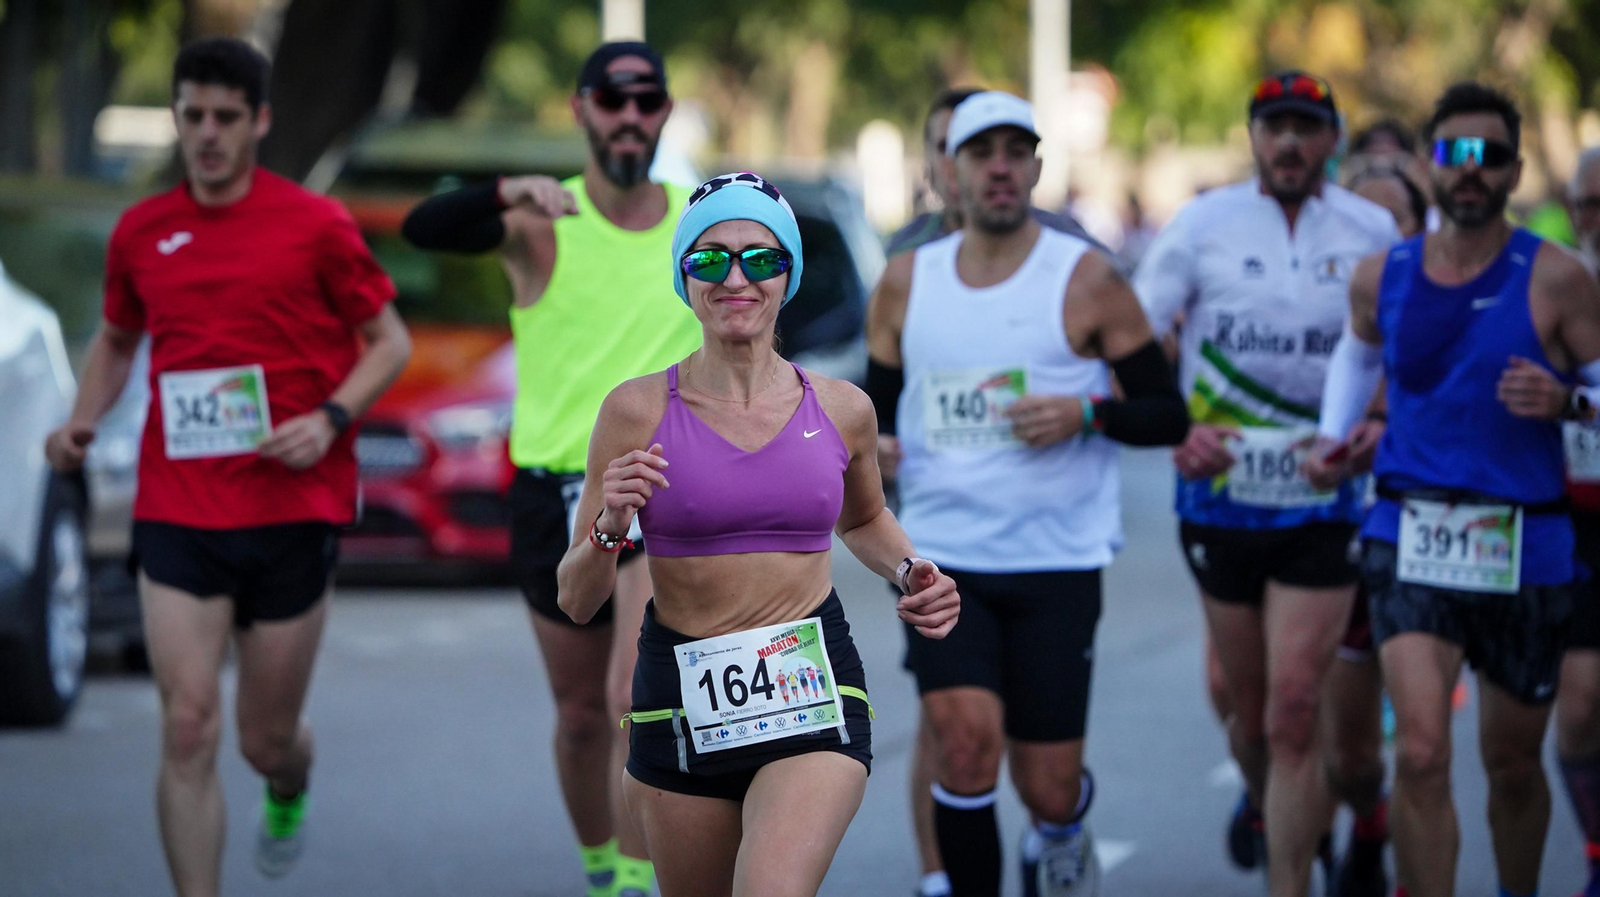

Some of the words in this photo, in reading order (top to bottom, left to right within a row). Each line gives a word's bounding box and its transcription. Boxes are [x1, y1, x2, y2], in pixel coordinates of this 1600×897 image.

[173, 392, 220, 429] 342
[935, 389, 987, 426] 140
[1243, 448, 1297, 481] 180
[1414, 524, 1470, 559] 391
[780, 629, 796, 640] MEDIA
[698, 658, 776, 712] 164
[719, 710, 737, 719] SONIA
[736, 707, 754, 715] FIERRO
[753, 704, 767, 712] SOTO
